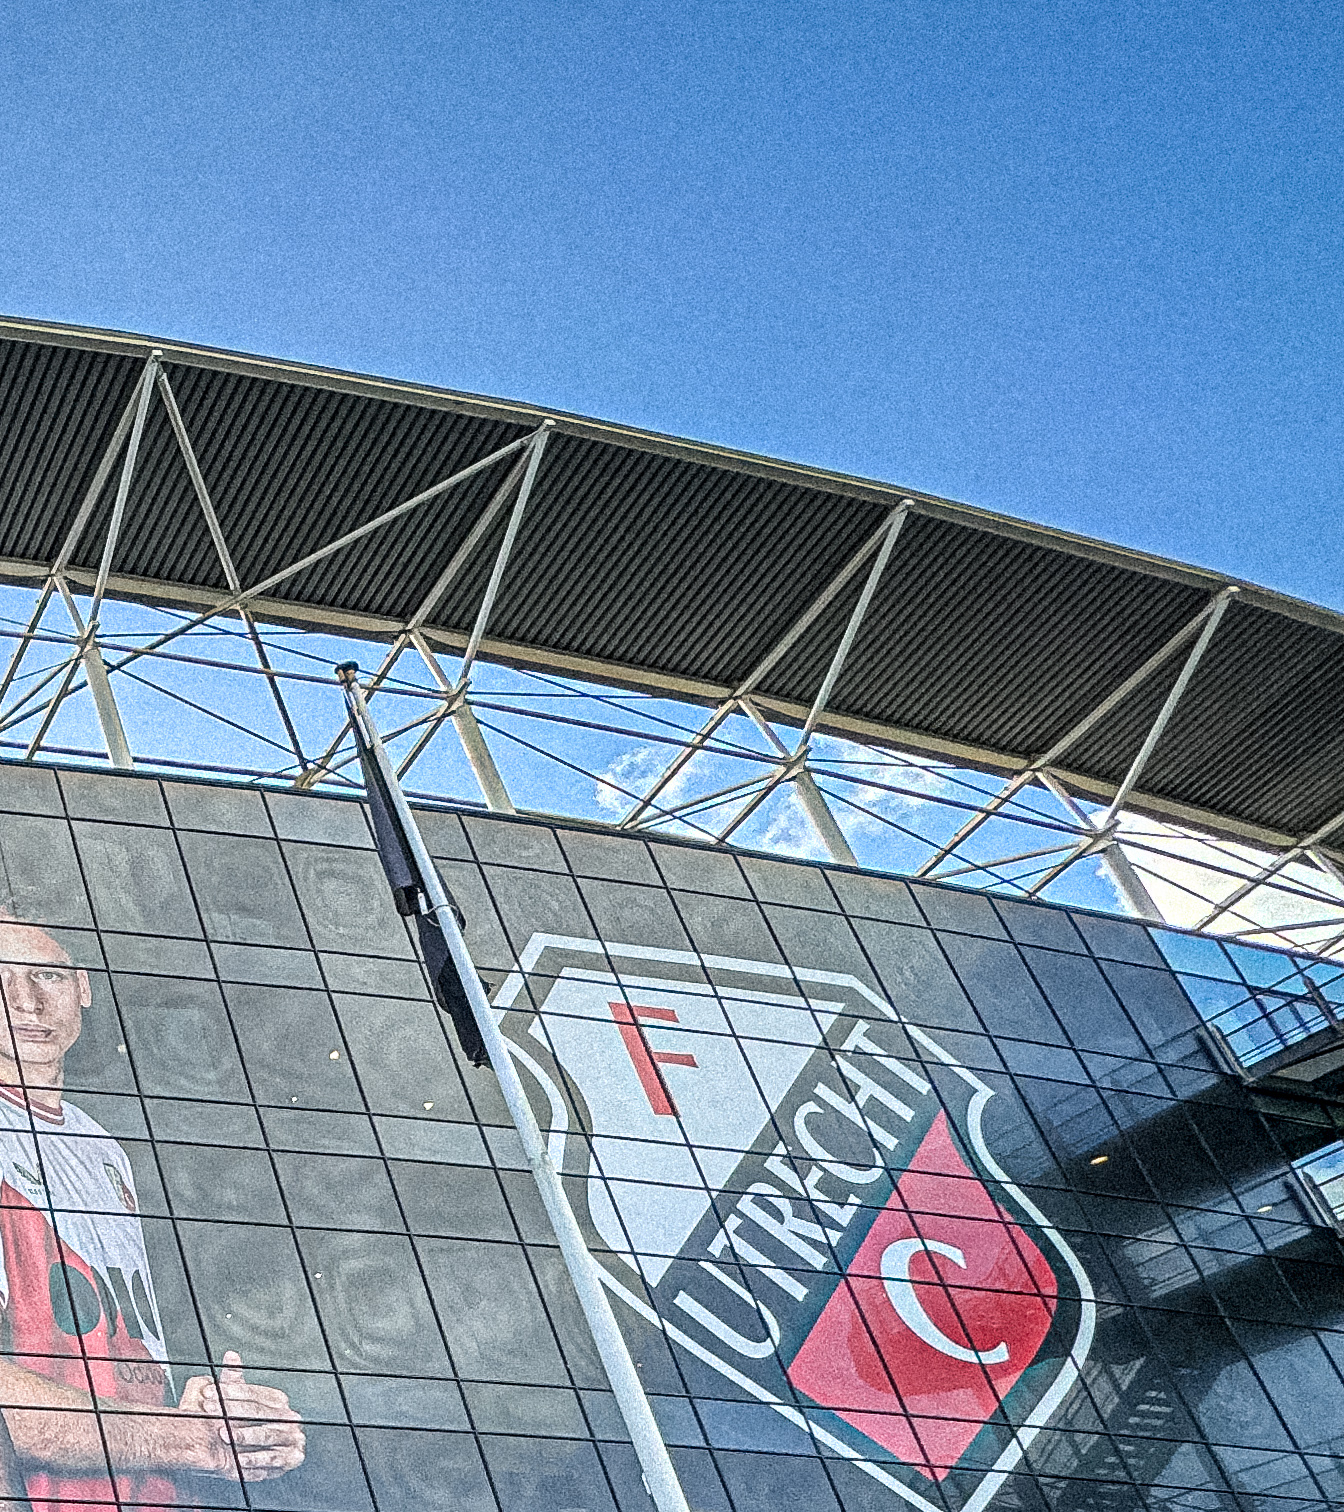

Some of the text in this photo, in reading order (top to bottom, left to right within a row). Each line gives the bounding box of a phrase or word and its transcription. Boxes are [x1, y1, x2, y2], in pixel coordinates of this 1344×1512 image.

[609, 1001, 699, 1118] F
[672, 1020, 932, 1360] UTRECHT
[879, 1237, 1010, 1365] C
